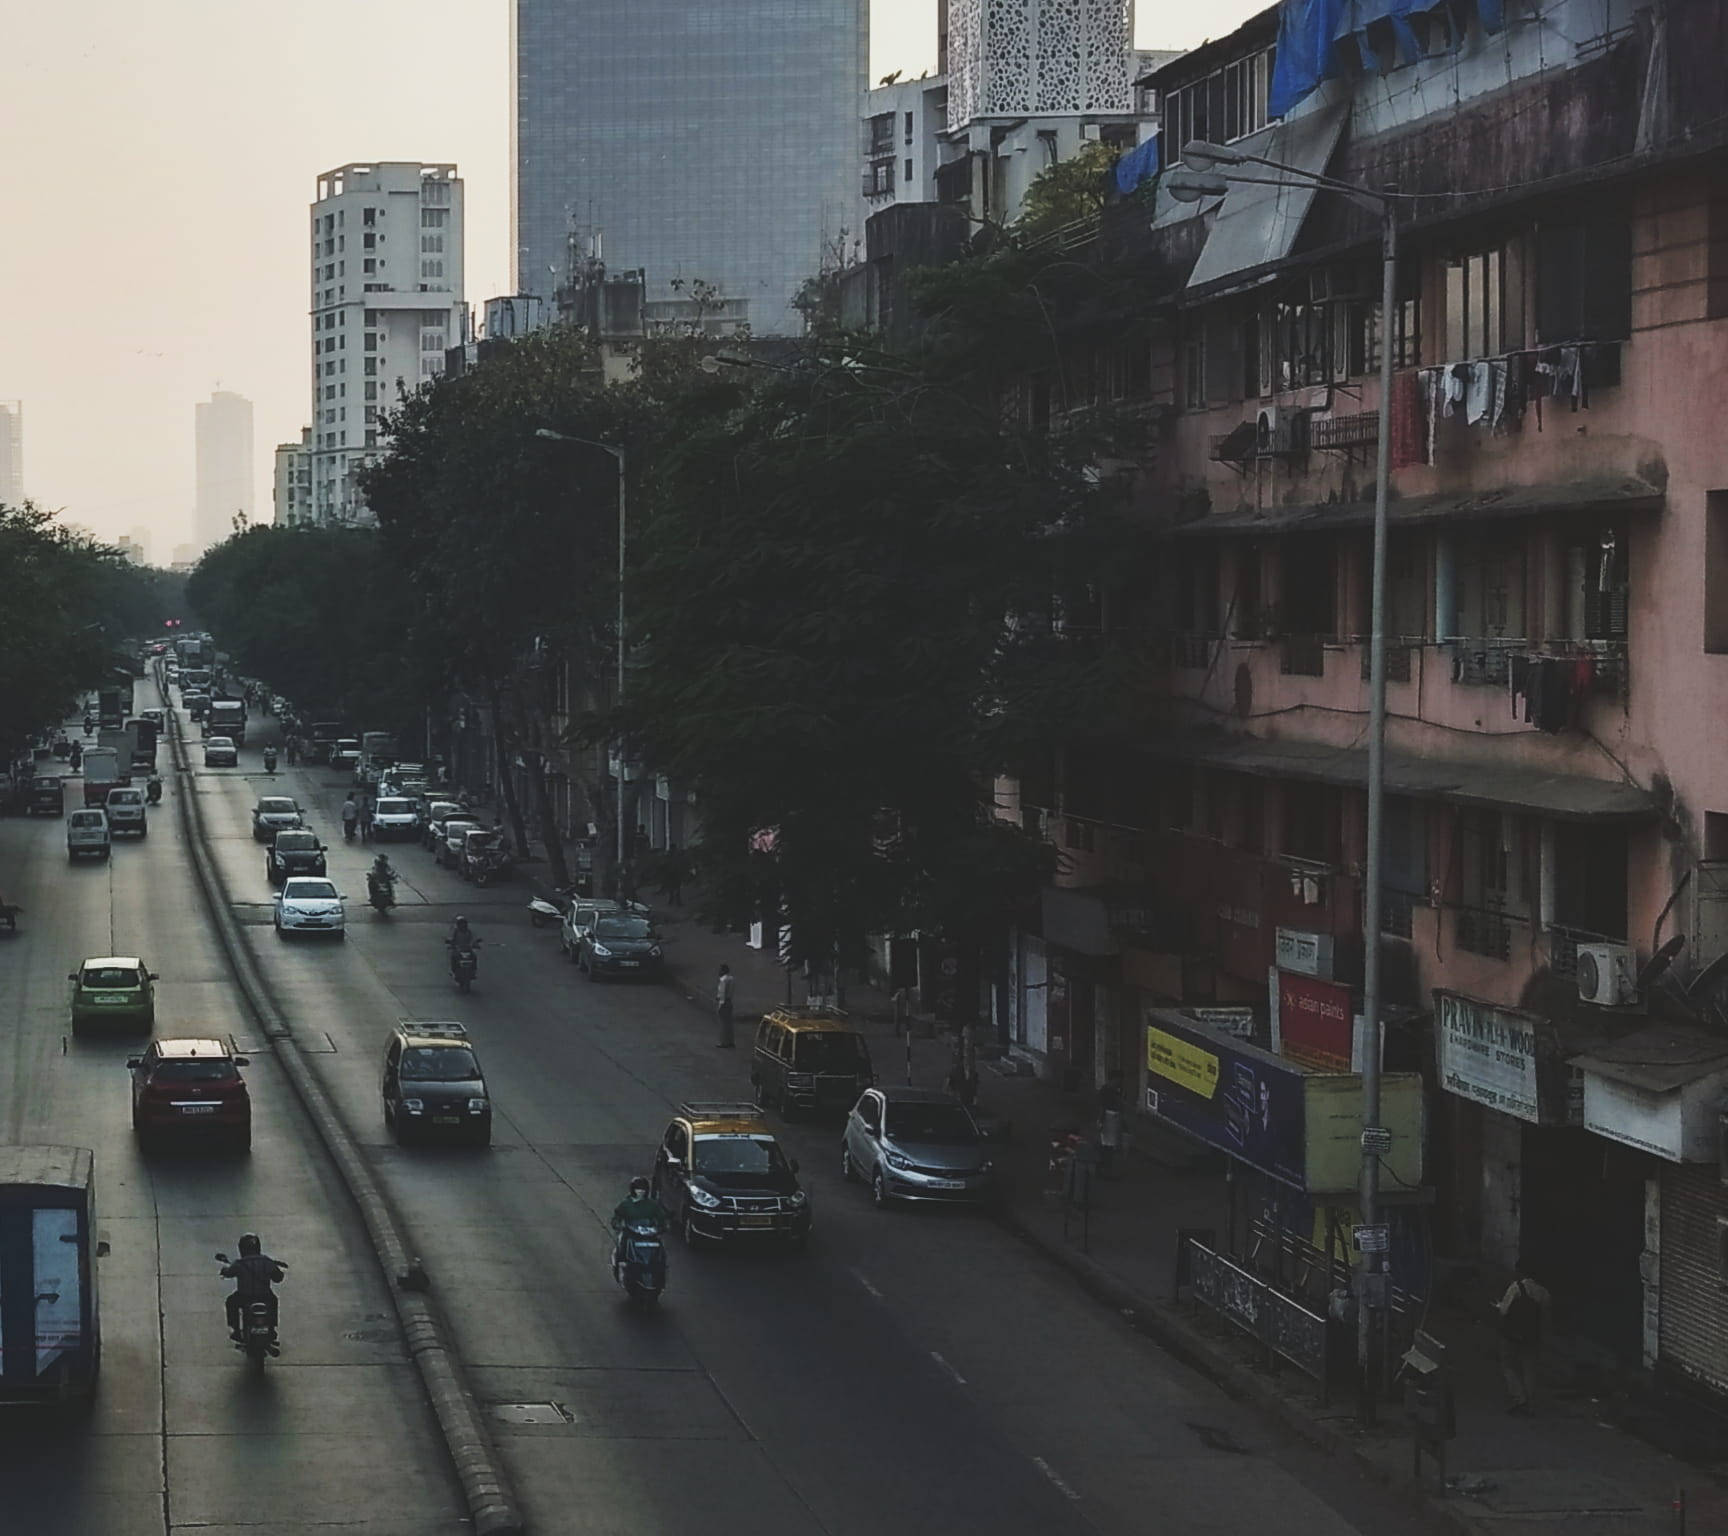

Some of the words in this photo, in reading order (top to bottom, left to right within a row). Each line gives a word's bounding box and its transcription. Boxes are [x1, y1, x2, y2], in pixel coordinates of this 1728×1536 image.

[1298, 993, 1319, 1013] asian
[1320, 998, 1345, 1022] paints
[1496, 1050, 1526, 1072] STORES
